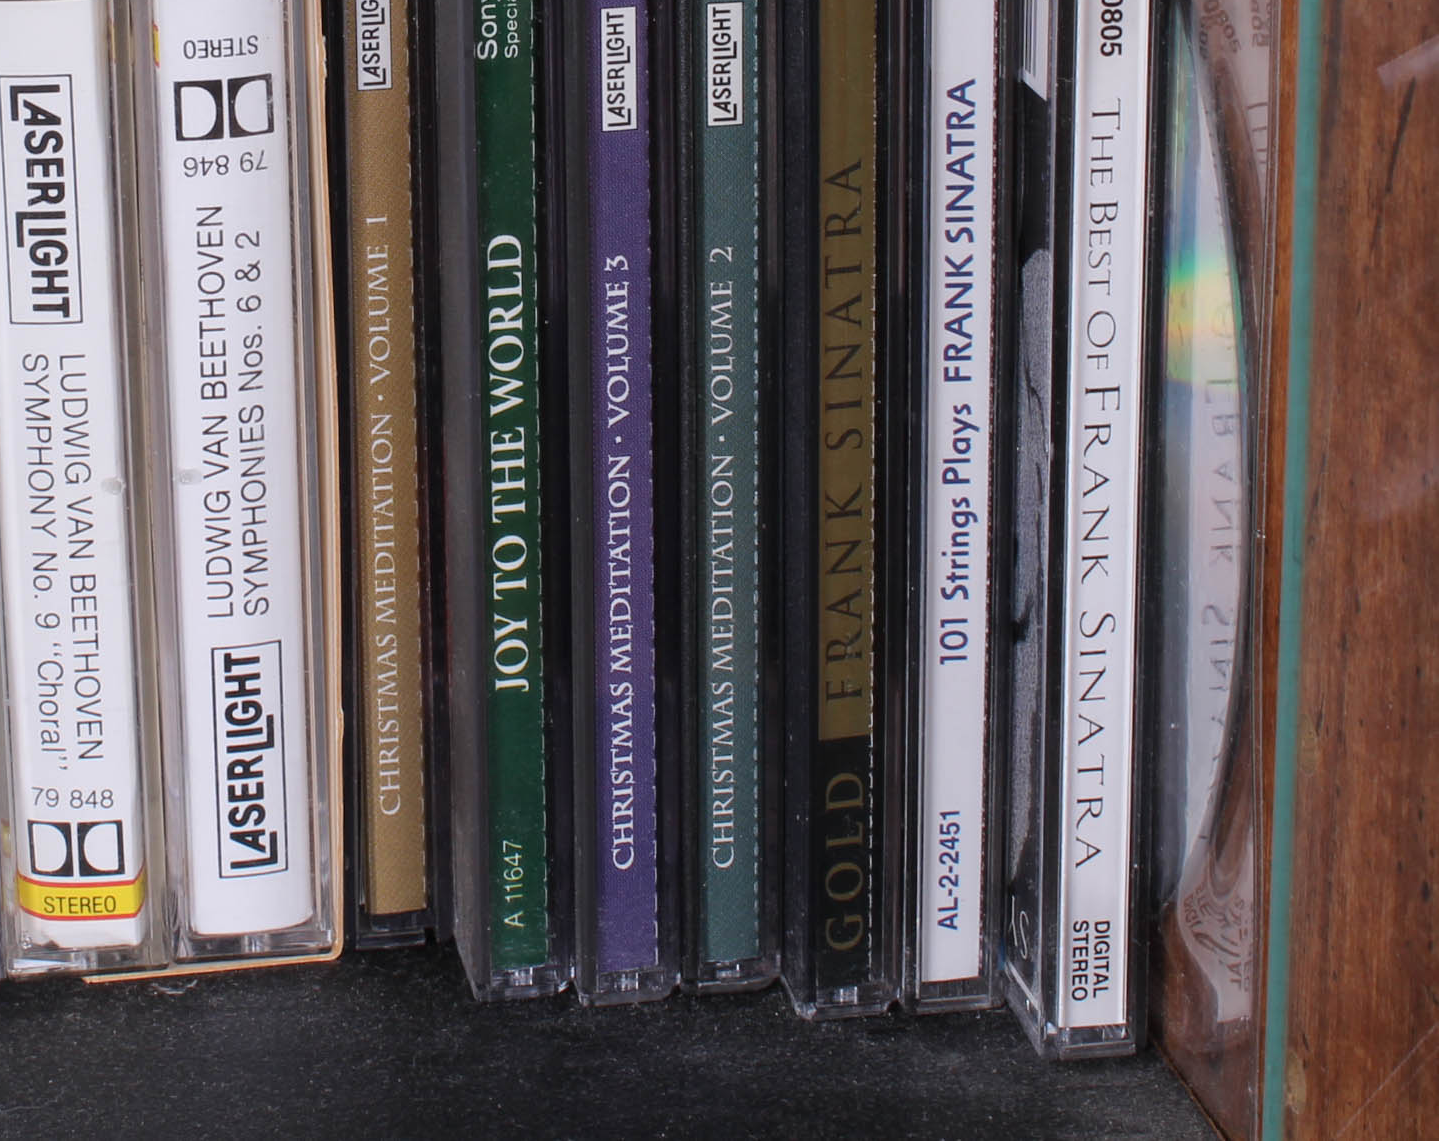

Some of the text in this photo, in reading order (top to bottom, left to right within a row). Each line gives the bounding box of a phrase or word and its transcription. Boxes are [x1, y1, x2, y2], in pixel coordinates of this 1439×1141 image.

[182, 34, 259, 59] STEREO
[182, 149, 268, 178] 79 846
[607, 11, 632, 127] LASERLIGHT
[713, 7, 738, 122] LASERLIGHT
[9, 84, 71, 318] LASERLIGHT
[22, 353, 58, 599] SYMPHONY No.
[195, 206, 234, 618] LUDWIG VAN BEETHOVEN
[237, 325, 269, 616] SYMPHONIES Nos.
[487, 234, 529, 692] JOY TO THE WORLD
[939, 79, 980, 665] 101 Strings Plays FRANK SINATRA
[1075, 98, 1122, 869] THE BEST OF FRANK SINATRA
[59, 353, 104, 761] LUDWIG VAN BEETHOVEN
[367, 242, 401, 816] CHRISTMAS MEDITATION VOLUME
[606, 281, 634, 870] CHRISTMAS MEDITATION VOLUME
[711, 281, 735, 869] CHRISTMAS MEDITATION VOLUME
[824, 162, 865, 951] GOLD FRANK SINATRA
[31, 786, 115, 809] 79 848
[224, 652, 279, 870] LASERLIGHT
[937, 810, 961, 930] AL-2-2451
[43, 895, 117, 915] STEREO
[503, 839, 524, 927] A 11647
[1072, 921, 1088, 1001] STEREO
[1093, 921, 1110, 999] DIGITAL
